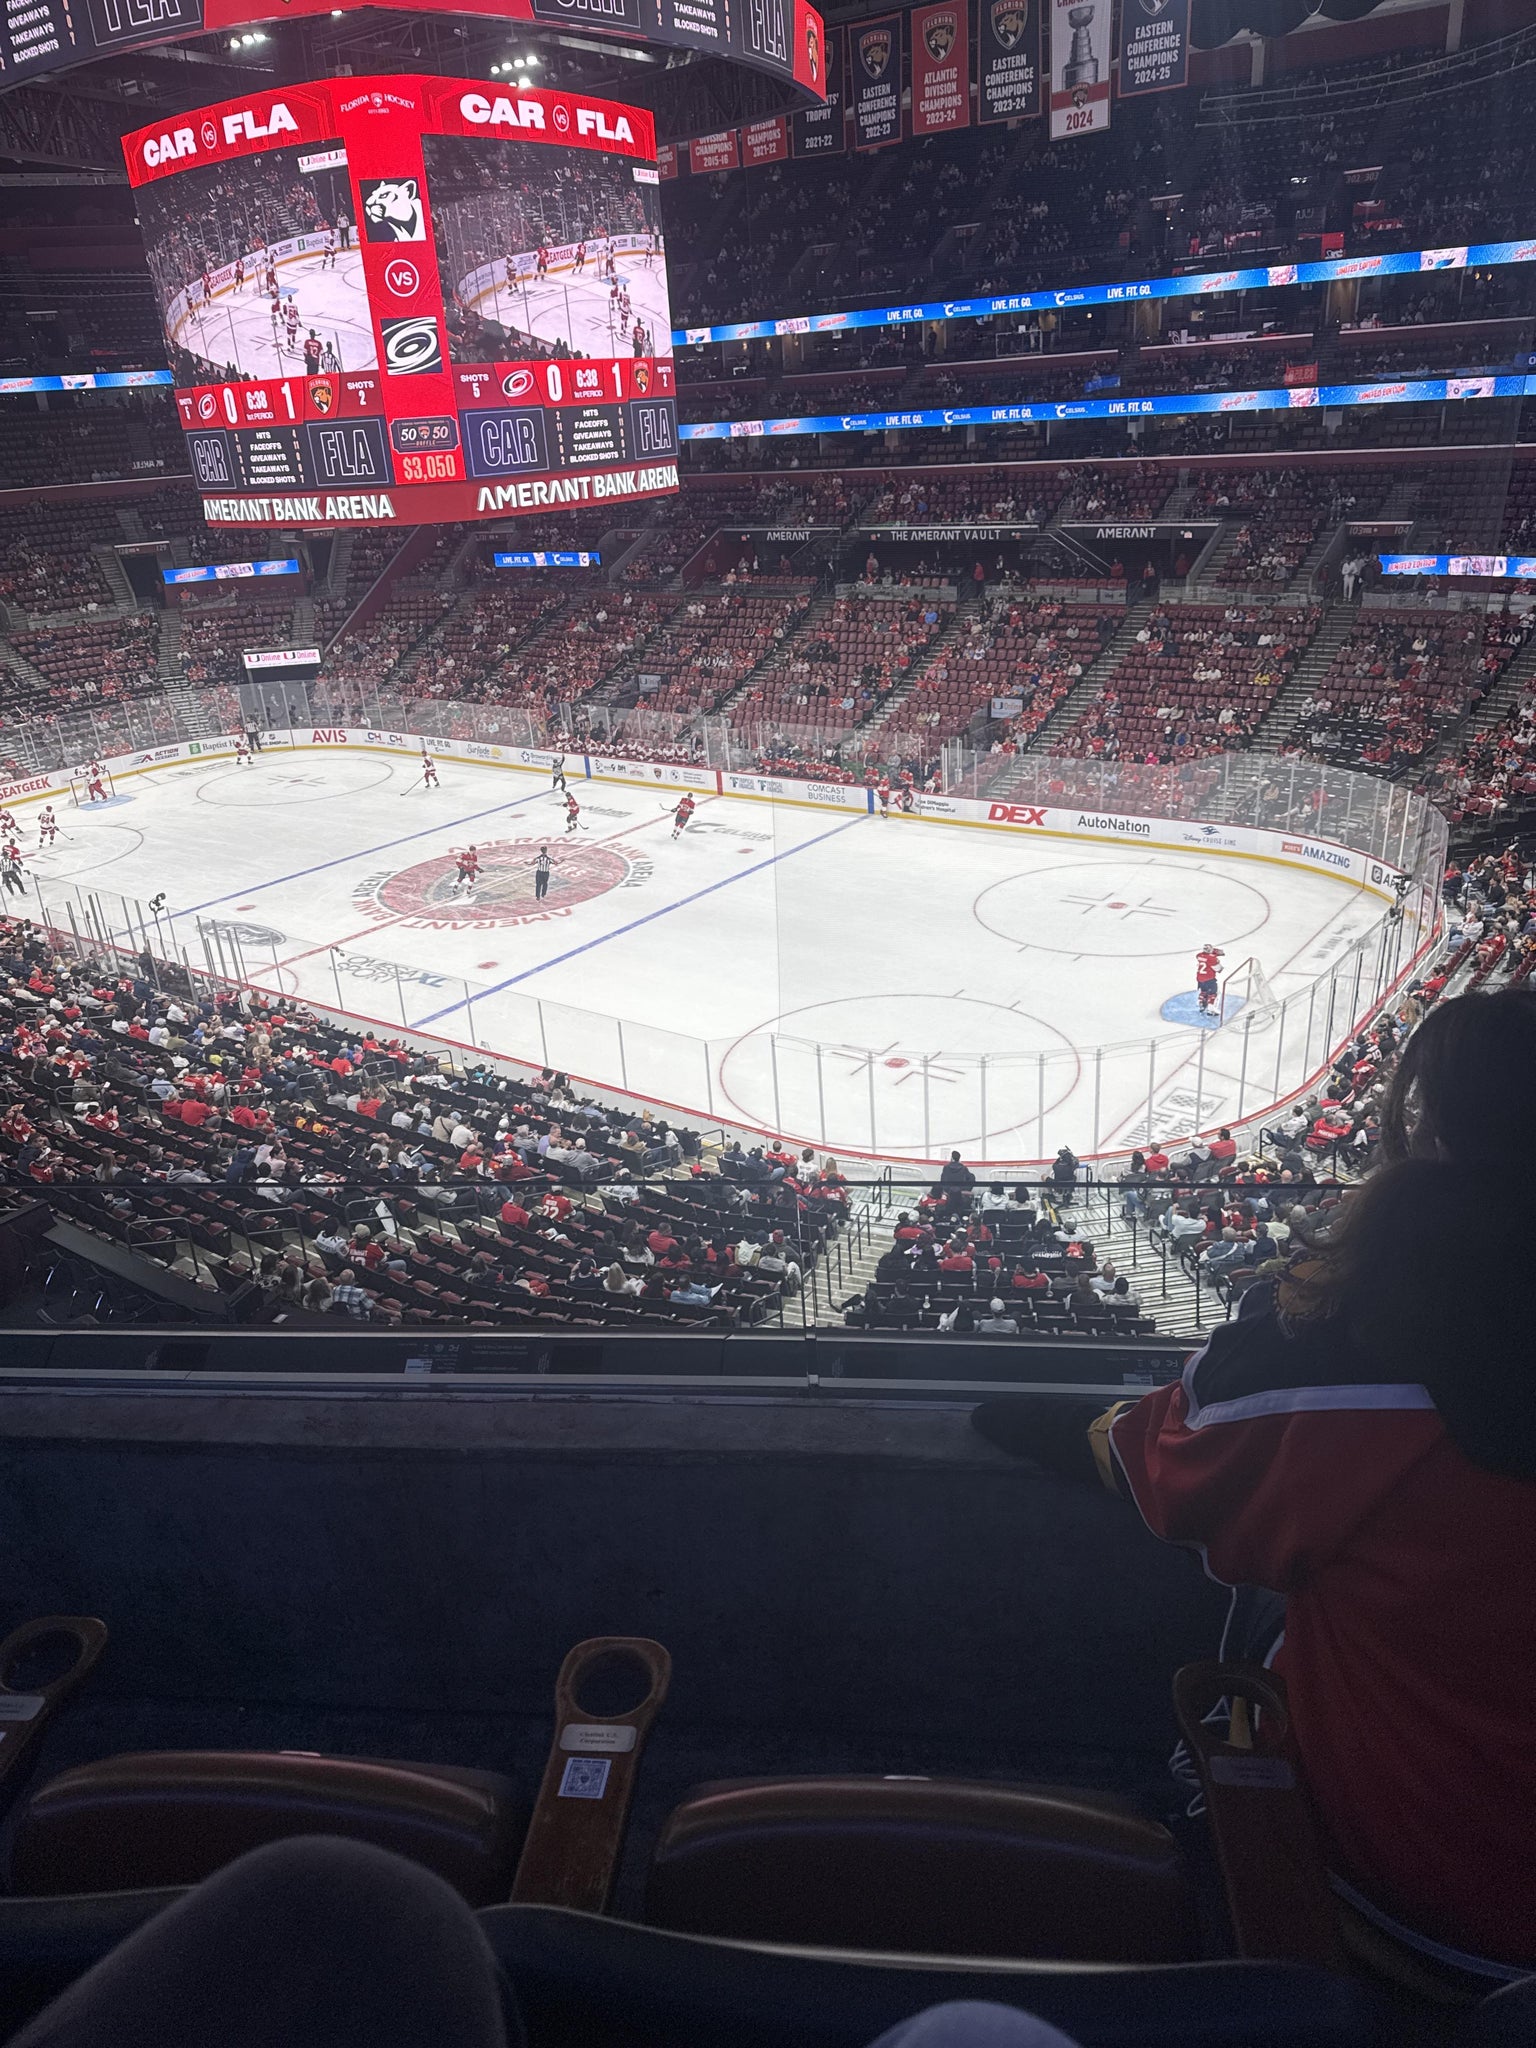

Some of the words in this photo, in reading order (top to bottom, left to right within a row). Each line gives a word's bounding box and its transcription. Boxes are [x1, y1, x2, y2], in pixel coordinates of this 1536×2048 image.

[7, 5, 50, 30] GIVEAWAYS
[674, 2, 716, 22] TAKEAWAYS
[10, 22, 55, 46] TAKEAWAYS
[674, 18, 700, 34] BLOCKED
[700, 24, 718, 38] SHOTS
[727, 30, 732, 42] 1
[1136, 20, 1174, 40] EASTERN
[13, 44, 38, 64] BLOCKED
[38, 39, 60, 54] SHOTS
[1127, 34, 1181, 56] CONFERENCE
[992, 54, 1026, 72] EASTERN
[1128, 50, 1178, 70] CHAMPIONS
[924, 68, 958, 85] ATLANTIC
[986, 68, 1034, 86] CONFERENCE
[1135, 66, 1170, 84] 2024-25
[862, 83, 890, 98] EASTERN
[925, 82, 956, 98] DIVISION
[986, 82, 1032, 100] CHAMPIONS
[340, 96, 370, 112] FLORIDA
[384, 94, 415, 110] HOCKEY
[858, 96, 896, 114] CONFERENCE
[920, 95, 962, 112] CHAMPIONS
[993, 97, 1026, 114] 2023-24
[460, 94, 546, 130] CAR
[556, 113, 566, 126] VS
[576, 108, 634, 144] FLA
[805, 108, 832, 123] TROPHY
[860, 109, 896, 126] CHAMPIONS
[926, 110, 956, 125] 2023-24
[1066, 110, 1093, 130] 2024
[750, 119, 776, 132] DIVISION
[866, 123, 890, 138] 2022-23
[144, 128, 197, 167] CAR
[204, 130, 214, 141] VS
[222, 103, 298, 144] FLA
[699, 132, 728, 144] DIVISION
[747, 128, 781, 145] CHAMPIONS
[804, 135, 832, 149] 2021-22
[695, 142, 732, 156] CHAMPIONS
[753, 142, 776, 157] 2021-22
[704, 156, 728, 167] 2015-16
[392, 272, 413, 286] VS
[1064, 293, 1084, 301] CELSIUS
[1108, 288, 1125, 298] LIVE.
[1126, 286, 1138, 296] FIT.
[1140, 285, 1152, 295] GO.
[992, 300, 1008, 310] LIVE.
[1009, 298, 1020, 308] FIT.
[1021, 297, 1032, 308] GO.
[886, 310, 904, 321] LIVE.
[347, 380, 374, 390] SHOTS
[460, 374, 489, 382] SHOTS
[546, 364, 562, 402] 0
[576, 369, 598, 388] 6:38
[612, 362, 622, 398] 1
[663, 374, 668, 387] 2
[358, 391, 366, 406] 2
[473, 383, 480, 398] 5
[223, 387, 238, 424] 0
[246, 390, 268, 410] 6:38
[281, 382, 296, 419] 1
[1109, 404, 1126, 414] LIVE.
[1128, 402, 1140, 412] FIT.
[1142, 402, 1154, 412] GO.
[583, 409, 598, 417] HITS
[886, 416, 902, 425] LIVE.
[913, 414, 923, 424] GO.
[992, 410, 1008, 420] LIVE.
[1009, 409, 1020, 419] FIT.
[1021, 408, 1032, 418] GO.
[574, 420, 608, 428] FACEOFFS
[639, 408, 671, 450] FLA
[401, 428, 416, 441] 50
[432, 426, 448, 439] 50
[574, 430, 612, 440] GIVEAWAYS
[250, 442, 282, 450] FACEOFFS
[480, 418, 538, 466] CAR
[573, 441, 614, 450] TAKEAWAYS
[194, 440, 228, 482] CAR
[250, 454, 286, 462] GIVEAWAYS
[320, 430, 376, 476] FLA
[570, 453, 598, 462] BLOCKED
[598, 452, 618, 460] SHOTS
[251, 464, 290, 473] TAKEAWAYS
[402, 454, 456, 481] $3,050
[276, 475, 296, 483] SHOTS
[477, 477, 592, 512] AMERANT
[593, 470, 638, 498] BANK
[638, 464, 679, 492] ARENA
[204, 498, 272, 520] AMERANT
[272, 497, 323, 521] BANK
[325, 494, 395, 520] ARENA
[766, 532, 810, 541] AMERANT
[891, 530, 908, 540] THE
[910, 531, 960, 541] AMERANT
[964, 530, 1000, 540] VAULT
[1096, 528, 1156, 538] AMERANT
[261, 653, 280, 662] Online
[297, 651, 316, 660] Online
[312, 730, 347, 743] AVIS
[154, 748, 178, 756] ACTION
[202, 742, 222, 751] Baptist
[807, 784, 846, 795] COMCAST
[808, 792, 846, 804] BUSINESS
[988, 804, 1048, 826] DEX
[1077, 815, 1150, 834] AutoNation
[602, 842, 642, 862] BANK
[1303, 846, 1350, 868] AMAZING
[352, 900, 394, 922] BANK
[400, 908, 572, 930] AMERANT
[328, 962, 397, 984] SPORT
[347, 956, 418, 978] OMEGA
